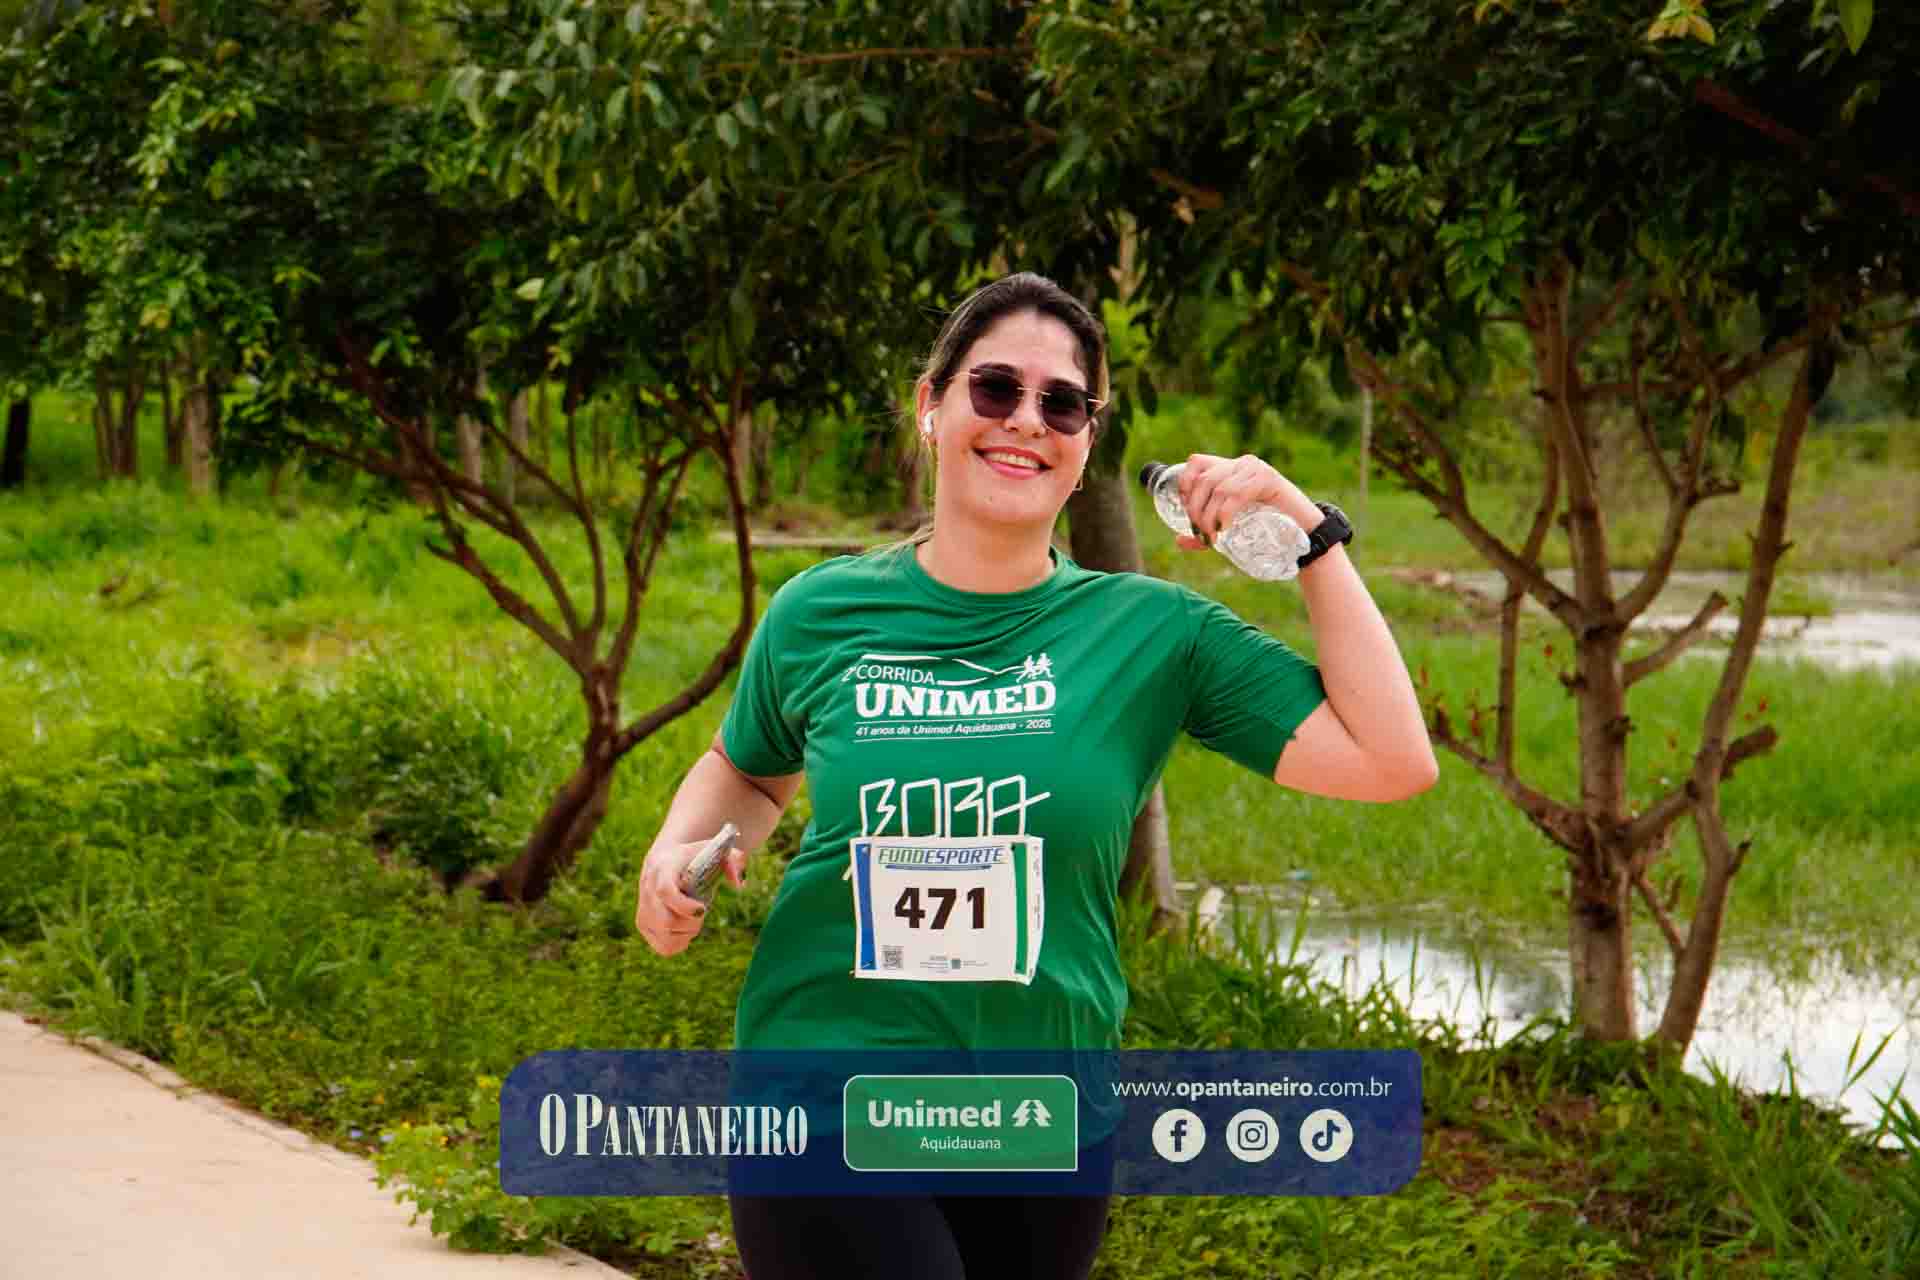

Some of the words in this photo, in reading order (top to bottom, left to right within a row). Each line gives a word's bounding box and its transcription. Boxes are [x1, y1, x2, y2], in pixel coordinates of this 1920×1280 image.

[856, 664, 936, 685] CORRIDA
[856, 681, 1056, 718] UNIMED
[855, 726, 868, 736] 41
[871, 726, 895, 736] anos
[912, 724, 953, 735] Unimed
[954, 722, 1016, 734] Aquidauana
[879, 848, 1004, 864] FUNDESPORTE
[894, 887, 985, 929] 471
